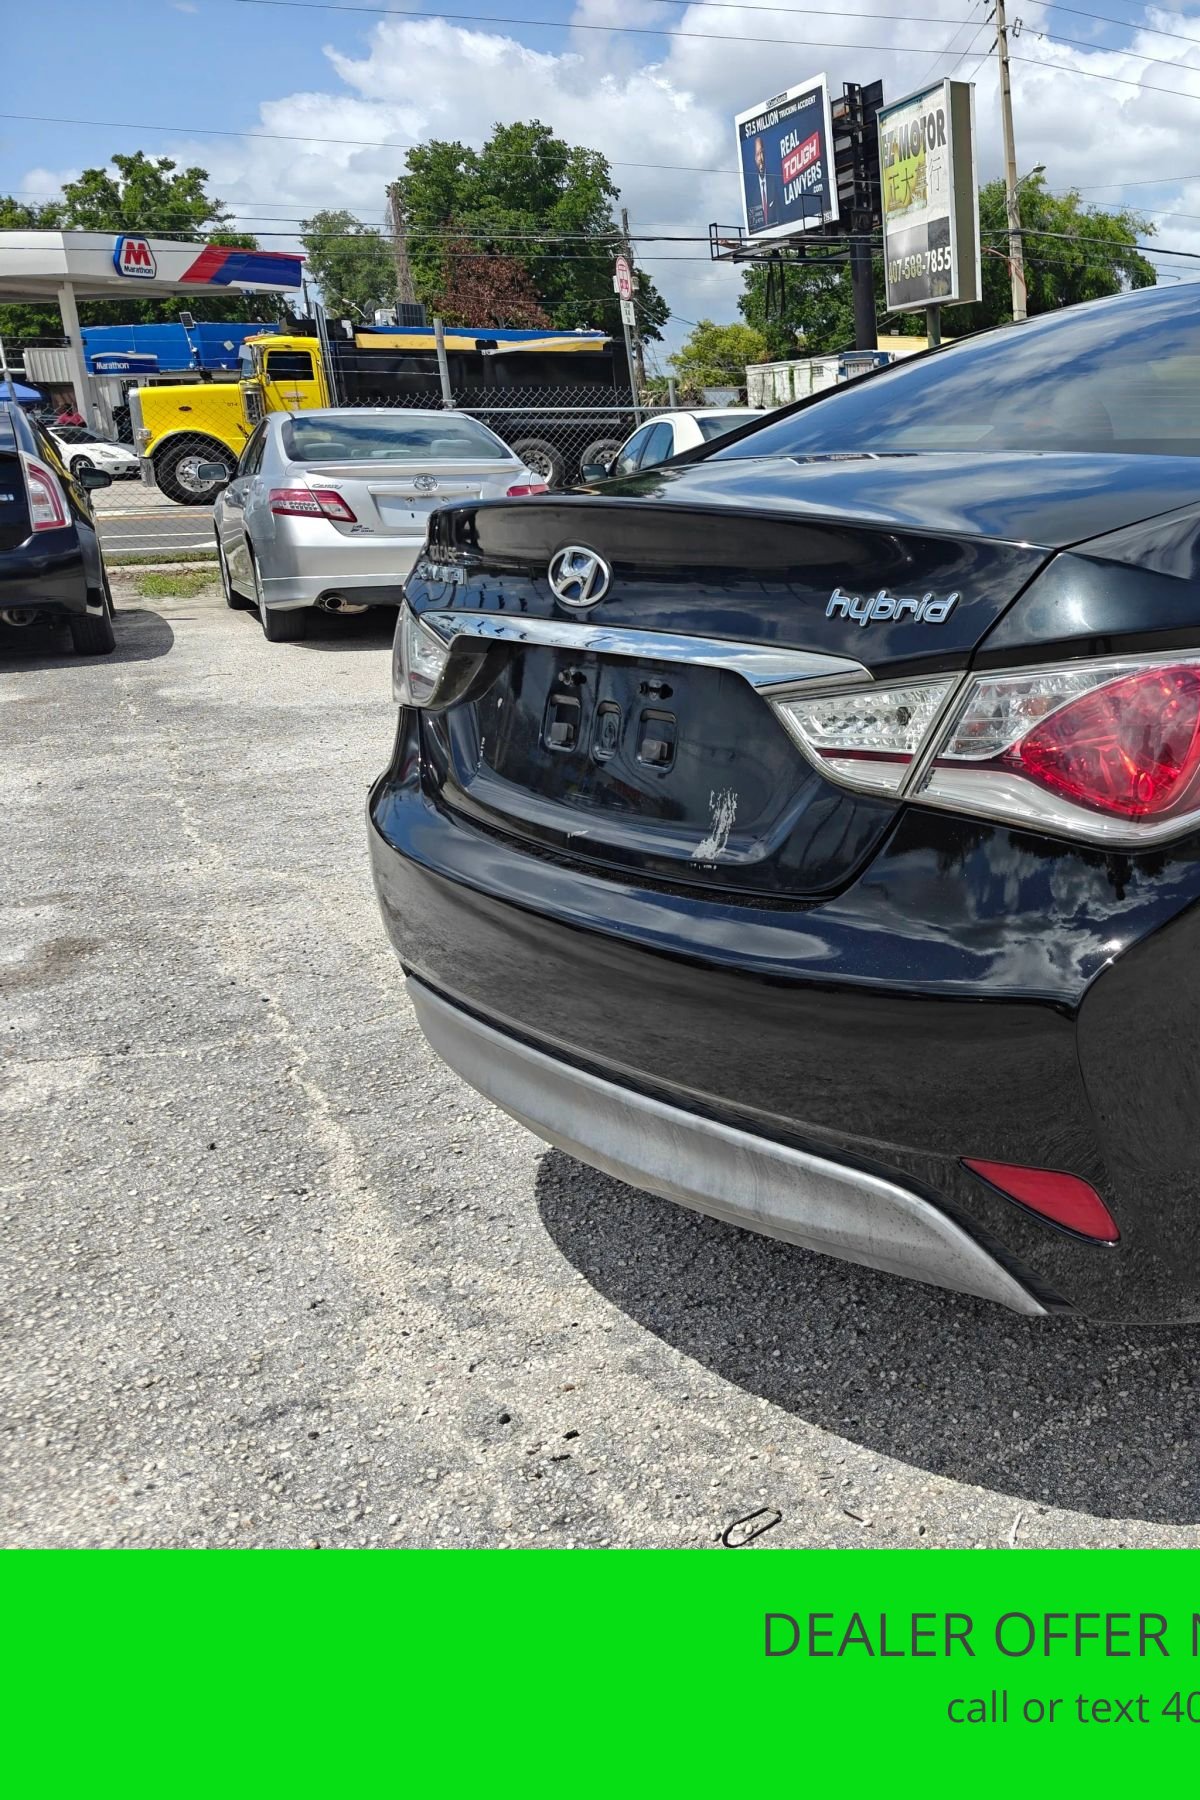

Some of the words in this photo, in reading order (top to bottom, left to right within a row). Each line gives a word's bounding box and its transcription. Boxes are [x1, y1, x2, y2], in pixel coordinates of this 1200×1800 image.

[756, 110, 779, 132] MILLION
[779, 104, 797, 118] TRUCKING
[797, 95, 816, 109] ACCIDENT
[780, 128, 800, 158] REAL
[899, 108, 947, 163] MOTOR
[783, 139, 817, 179] TOUGH
[783, 160, 822, 205] LAWYERS
[124, 265, 154, 275] Marathon
[888, 246, 952, 284] 407-588-7855
[96, 361, 129, 370] Marathon
[825, 588, 959, 627] hybrid
